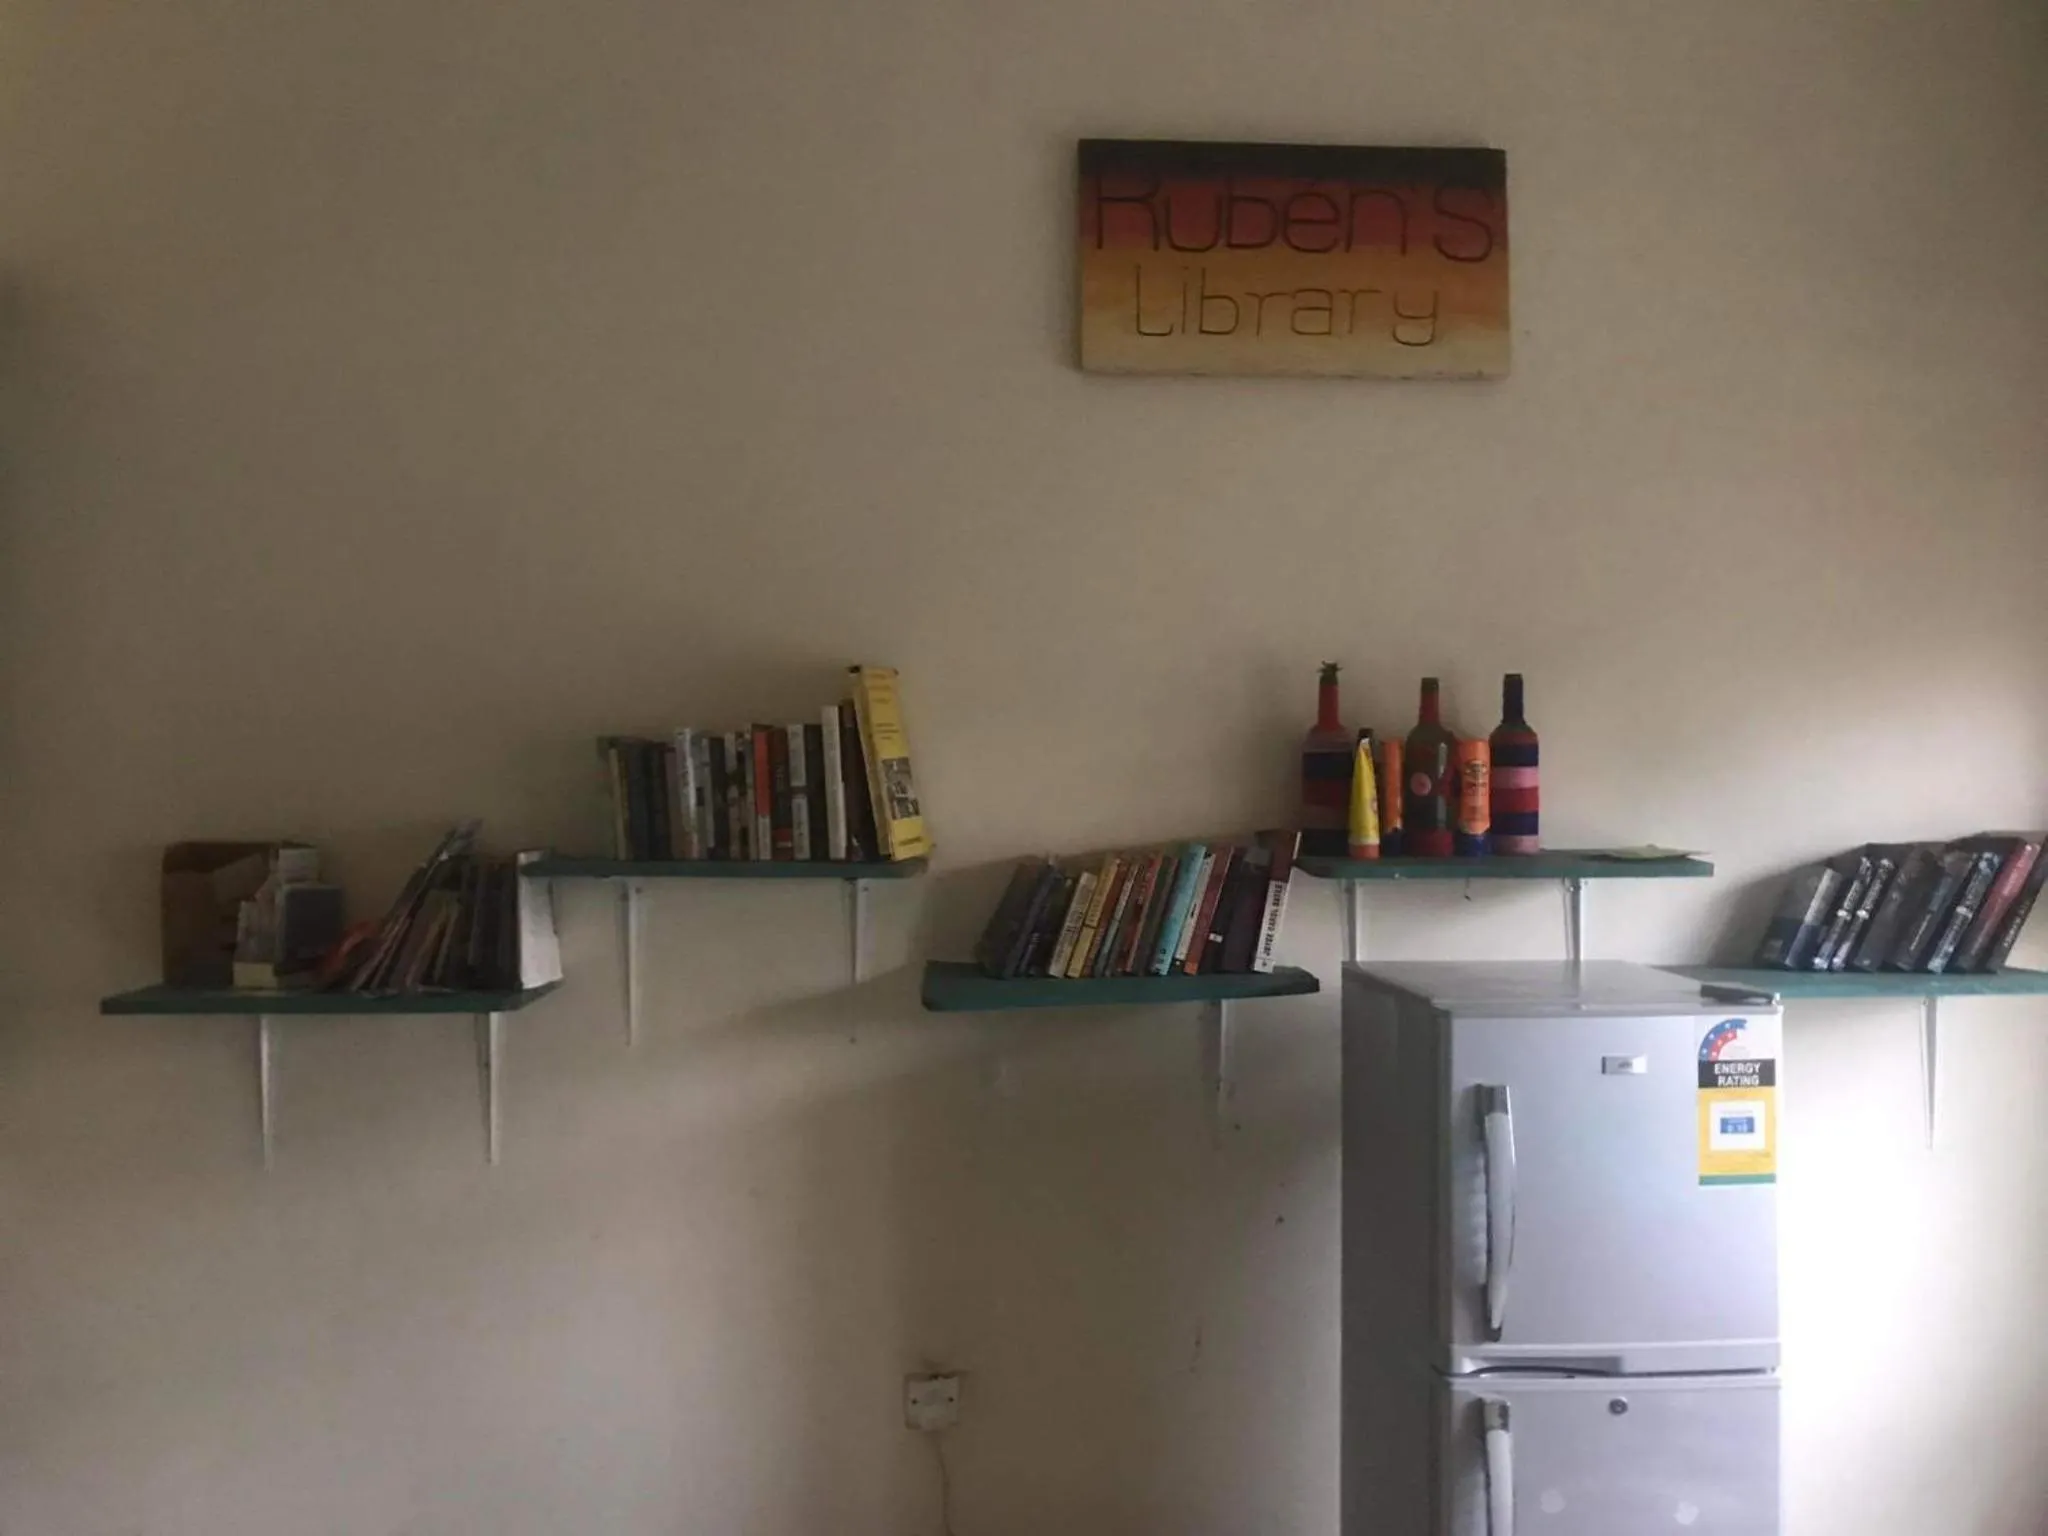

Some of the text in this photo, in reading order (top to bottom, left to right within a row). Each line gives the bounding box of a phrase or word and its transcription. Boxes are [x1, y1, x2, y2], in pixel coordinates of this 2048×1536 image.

[1135, 265, 1440, 346] Library
[1714, 1062, 1760, 1075] ENERGY
[1718, 1074, 1760, 1087] RATING
